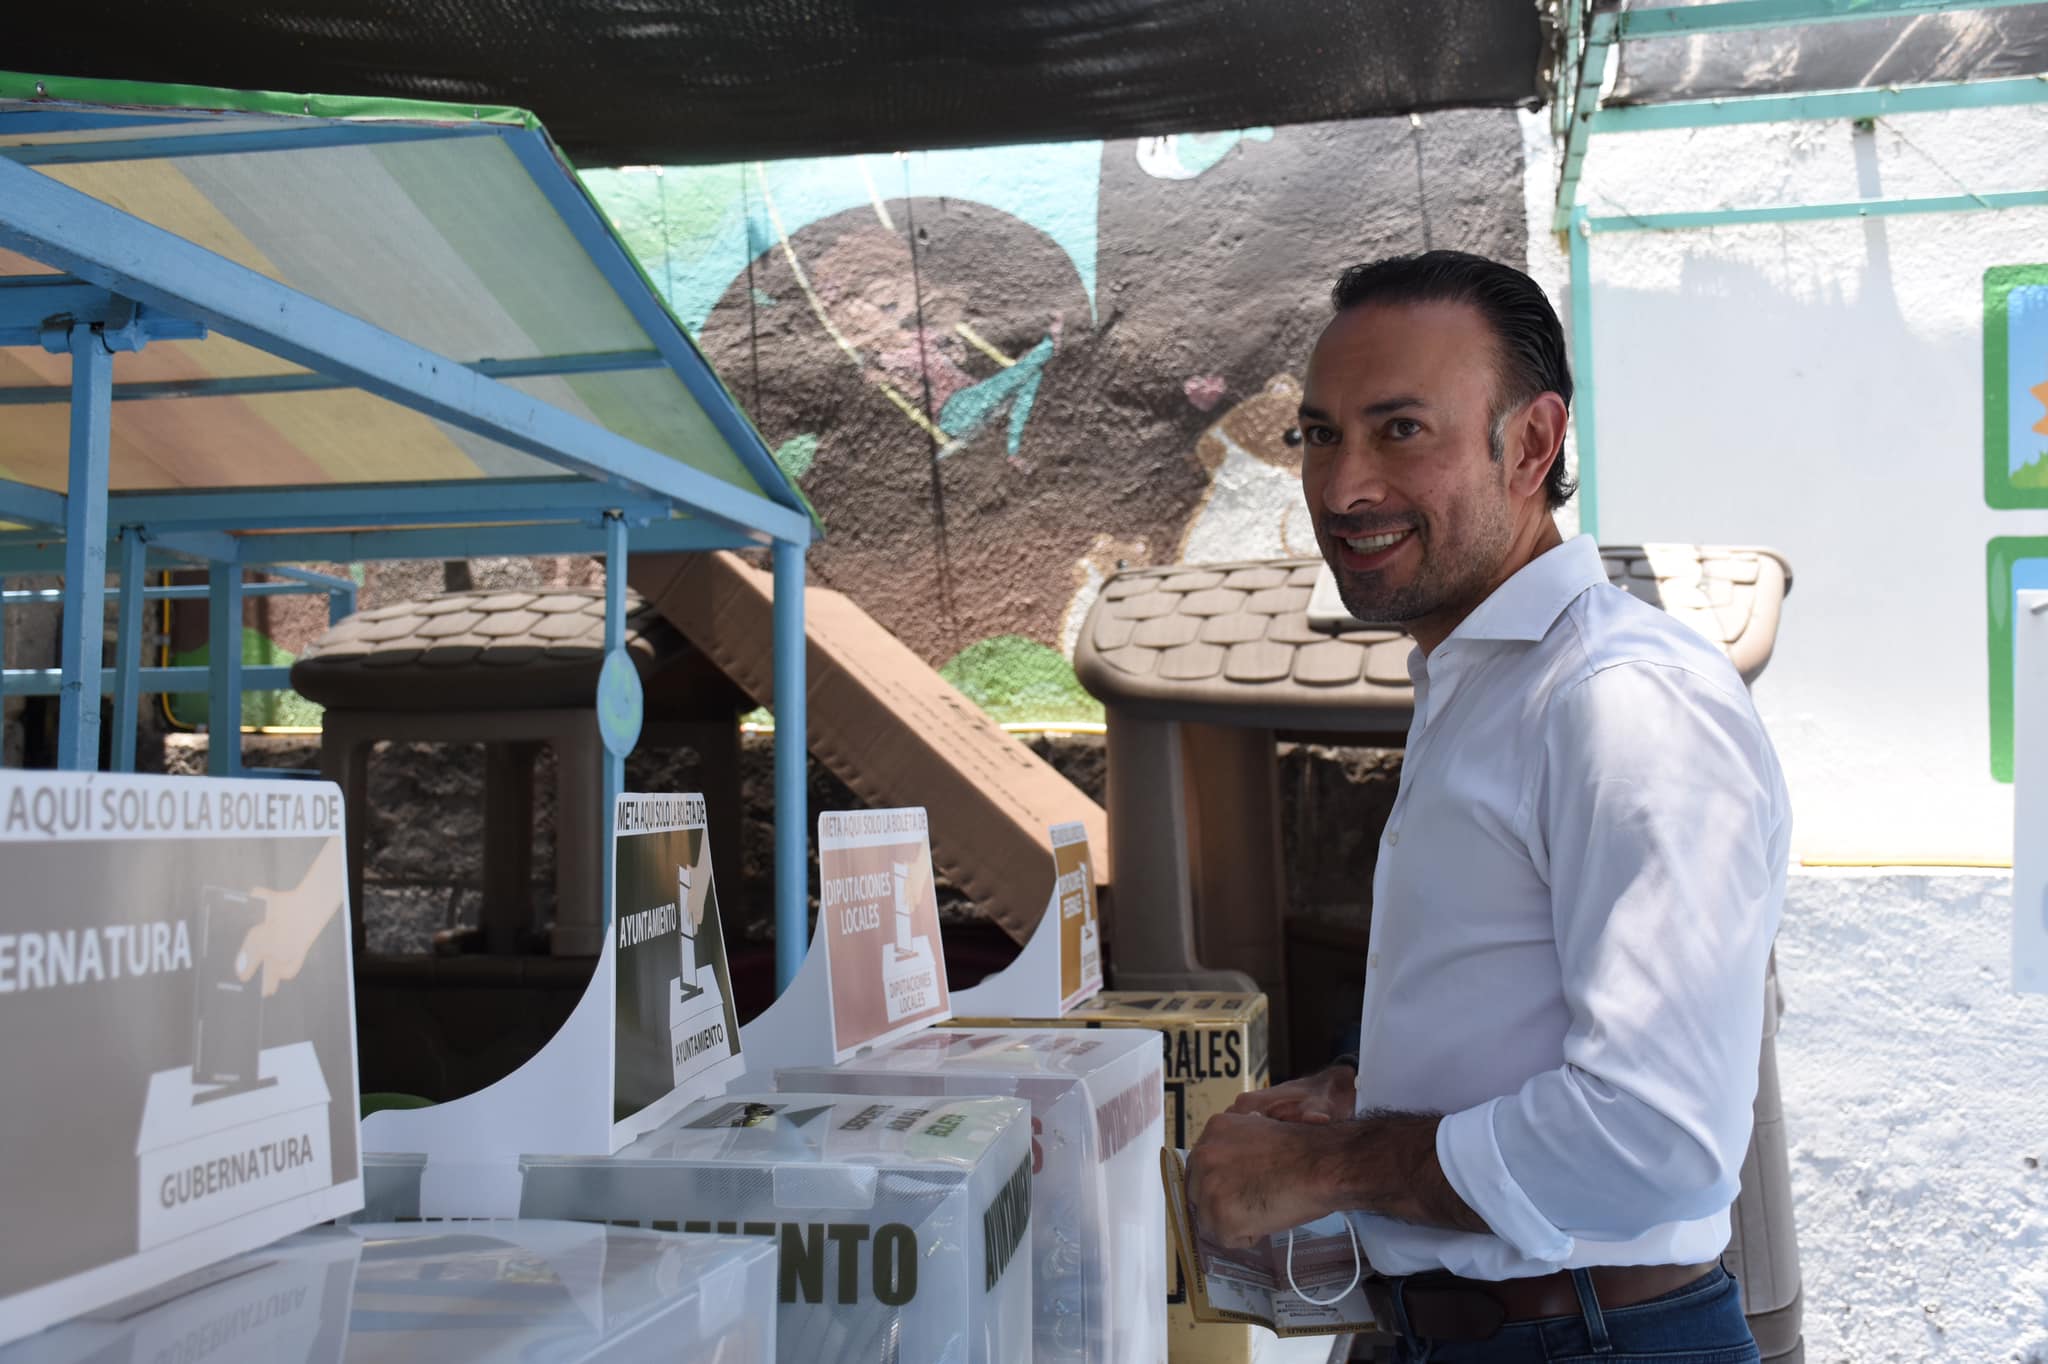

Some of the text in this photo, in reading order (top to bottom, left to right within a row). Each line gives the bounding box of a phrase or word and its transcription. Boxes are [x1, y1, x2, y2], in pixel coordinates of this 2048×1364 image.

[5, 775, 340, 836] AQUÍ SOLO LA BOLETA DE
[617, 801, 639, 831] META
[825, 871, 892, 908] DIPUTACIONES
[619, 902, 677, 949] AYUNTAMIENTO
[840, 903, 881, 936] LOCALES
[888, 971, 932, 999] DIPUTACIONES
[899, 991, 926, 1014] LOCALES
[675, 1022, 724, 1065] AYUNTAMIENTO
[160, 1133, 314, 1209] GUBERNATURA
